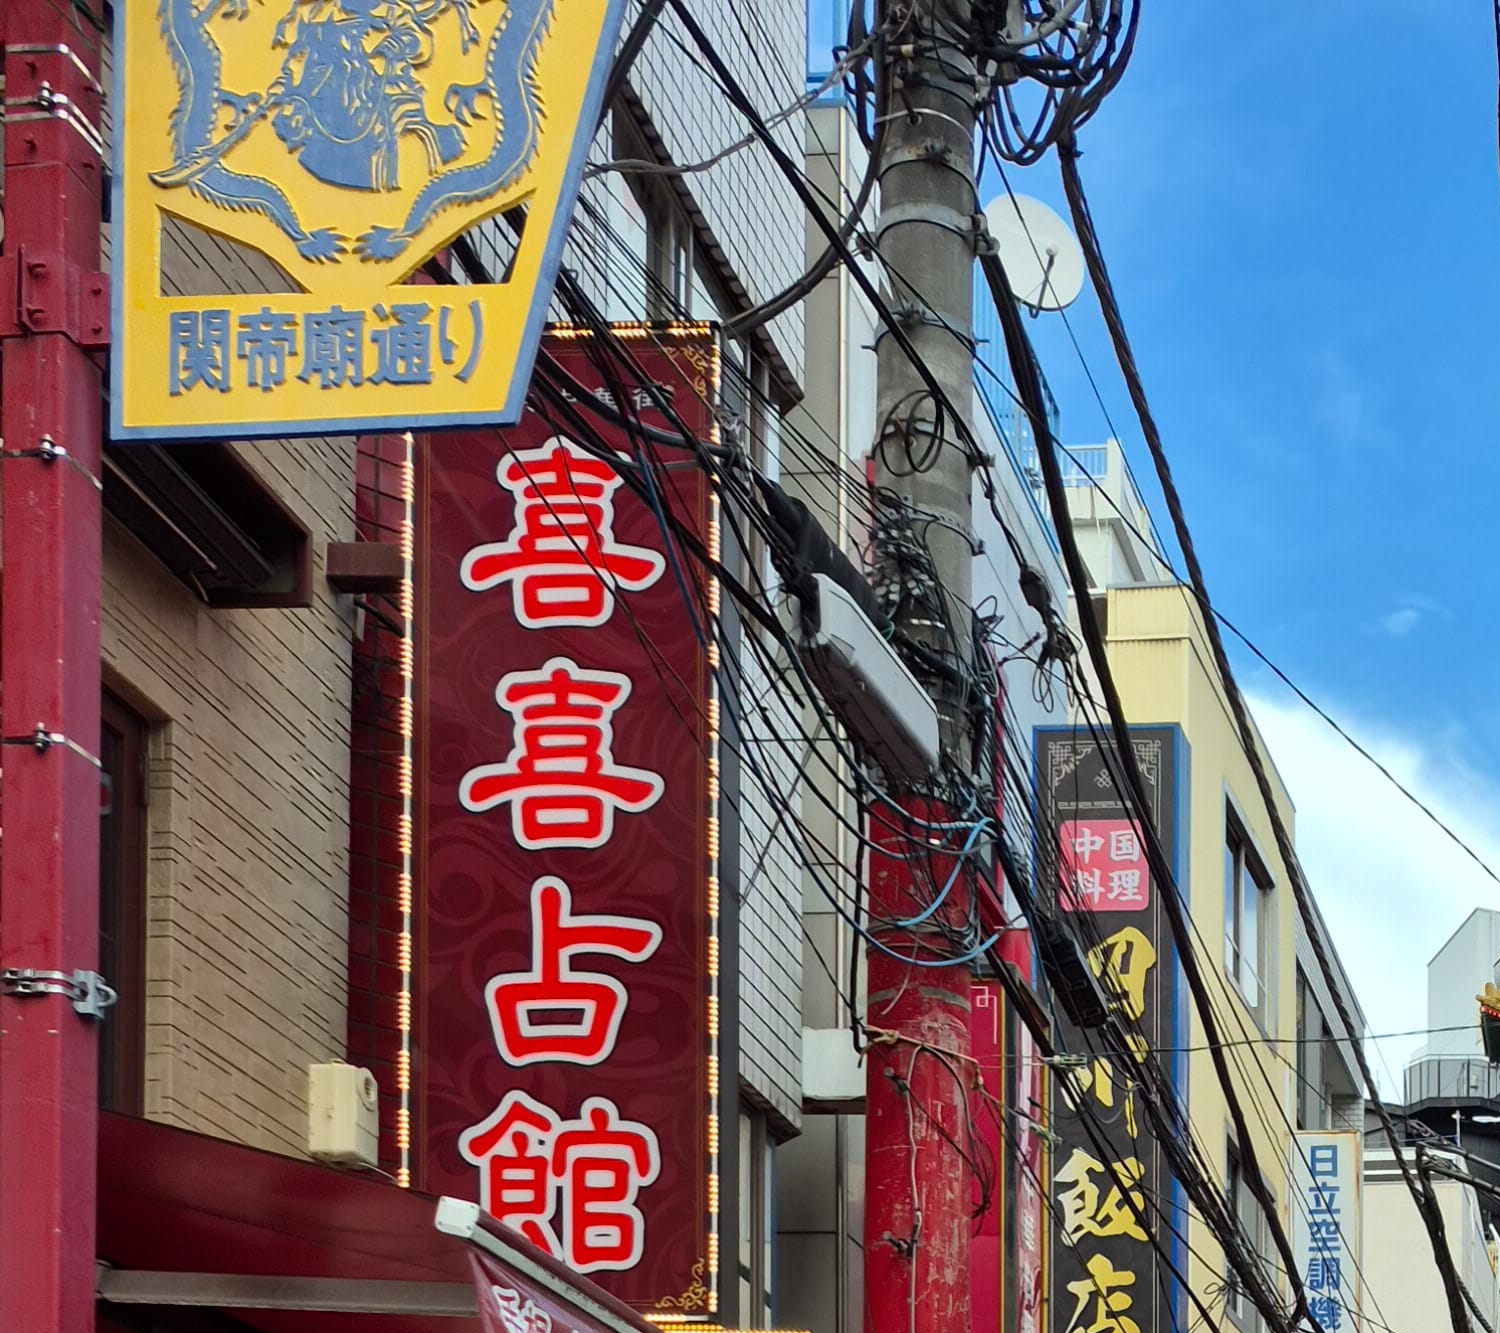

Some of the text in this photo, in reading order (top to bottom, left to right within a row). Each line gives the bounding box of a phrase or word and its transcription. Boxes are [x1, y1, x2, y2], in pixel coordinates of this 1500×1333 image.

[168, 300, 486, 396] 関帝廟通り
[458, 436, 667, 1272] 喜喜占館
[1072, 828, 1141, 863] 中国
[1073, 869, 1144, 903] 料理
